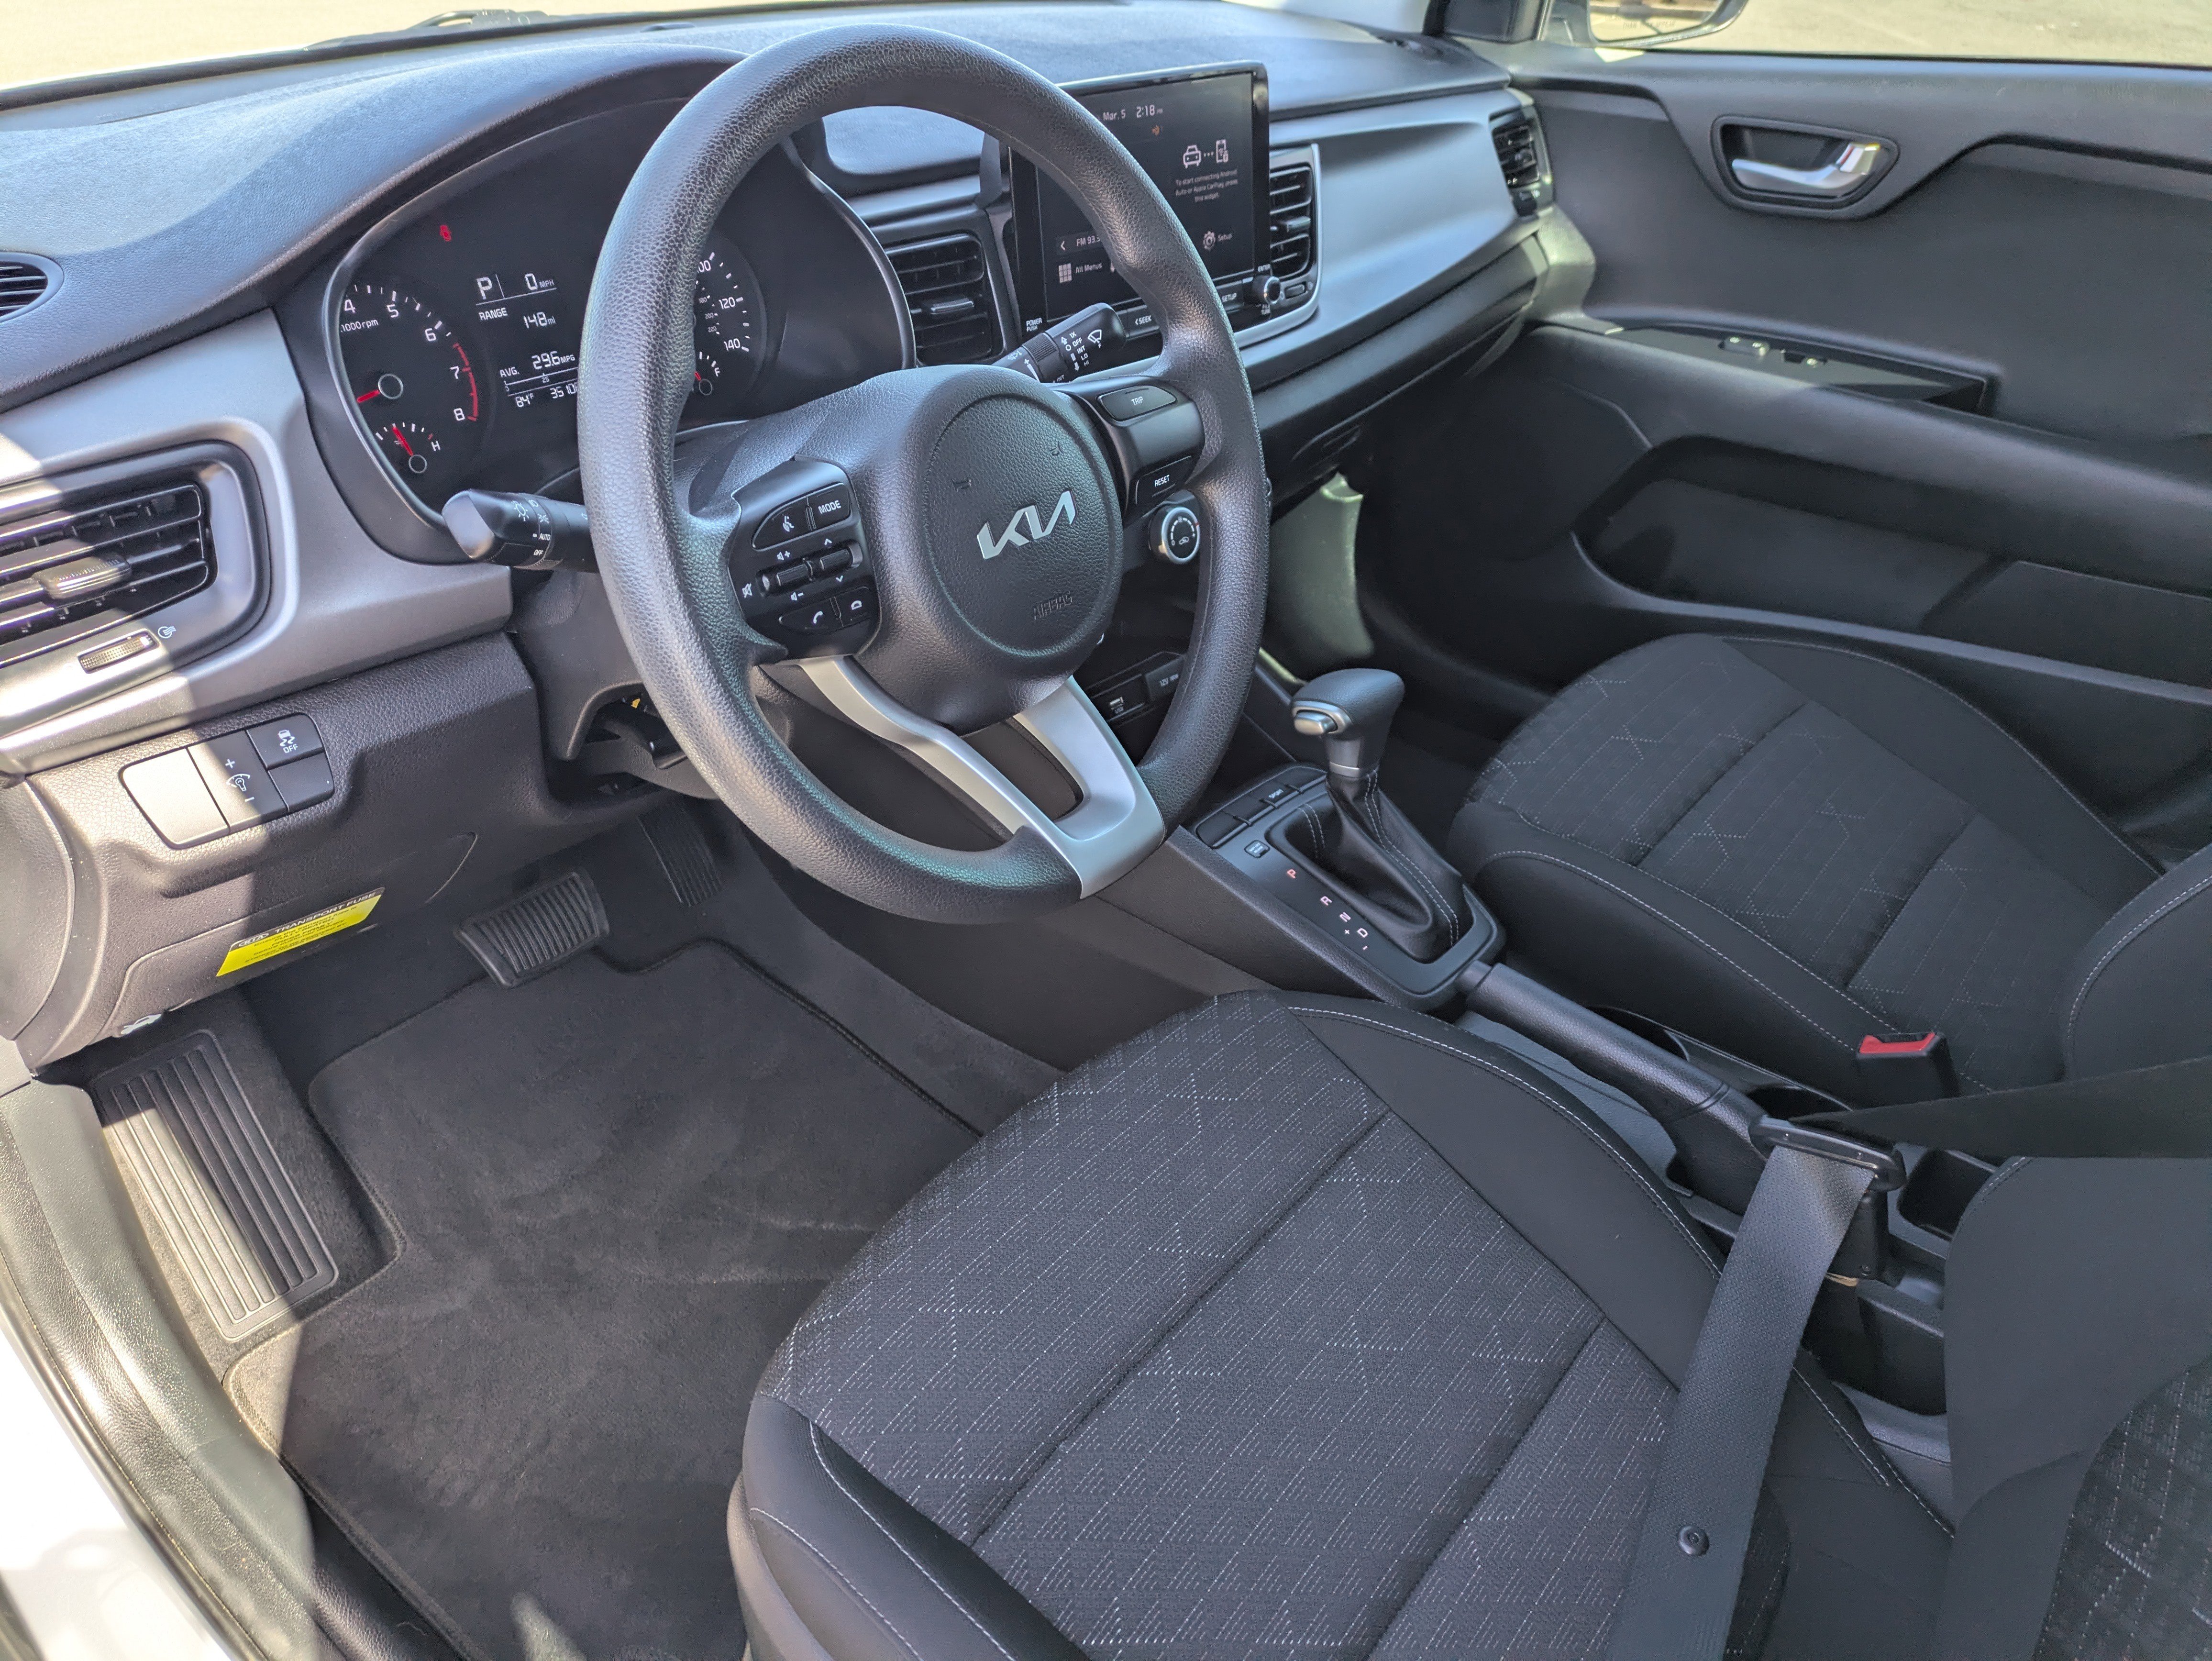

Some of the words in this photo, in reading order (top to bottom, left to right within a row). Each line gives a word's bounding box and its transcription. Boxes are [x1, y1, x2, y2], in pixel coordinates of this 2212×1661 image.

[1136, 104, 1155, 118] 2:18
[1076, 237, 1086, 246] FM
[697, 260, 711, 273] 00
[1084, 263, 1103, 272] Menus
[476, 277, 492, 300] P
[344, 299, 356, 313] 4
[719, 297, 736, 310] 120
[387, 304, 399, 318] 5
[479, 307, 508, 321] RANGE
[341, 319, 379, 332] 1000rpm
[1026, 317, 1042, 327] POWER
[425, 328, 437, 342] 6
[724, 338, 741, 351] 140
[1072, 337, 1083, 347] OFF
[1077, 345, 1086, 354] INT
[1081, 353, 1088, 361] LO
[450, 365, 460, 379] 7
[500, 366, 520, 378] AVG.
[714, 367, 720, 377] F
[1056, 374, 1065, 382] INT
[1131, 396, 1143, 405] TRIP
[453, 408, 465, 421] 8
[431, 440, 441, 452] H
[1154, 475, 1170, 487] RESET
[818, 500, 841, 515] MODE
[977, 490, 1078, 560] KIA
[539, 533, 551, 541] AUTO
[1033, 591, 1073, 620] AIRBAG
[282, 743, 299, 754] OFF
[1286, 869, 1296, 879] P
[1320, 896, 1332, 906] R
[275, 904, 346, 933] TRANSPORT
[346, 892, 376, 907] FUSE
[1339, 912, 1351, 922] N
[1357, 928, 1368, 938] D
